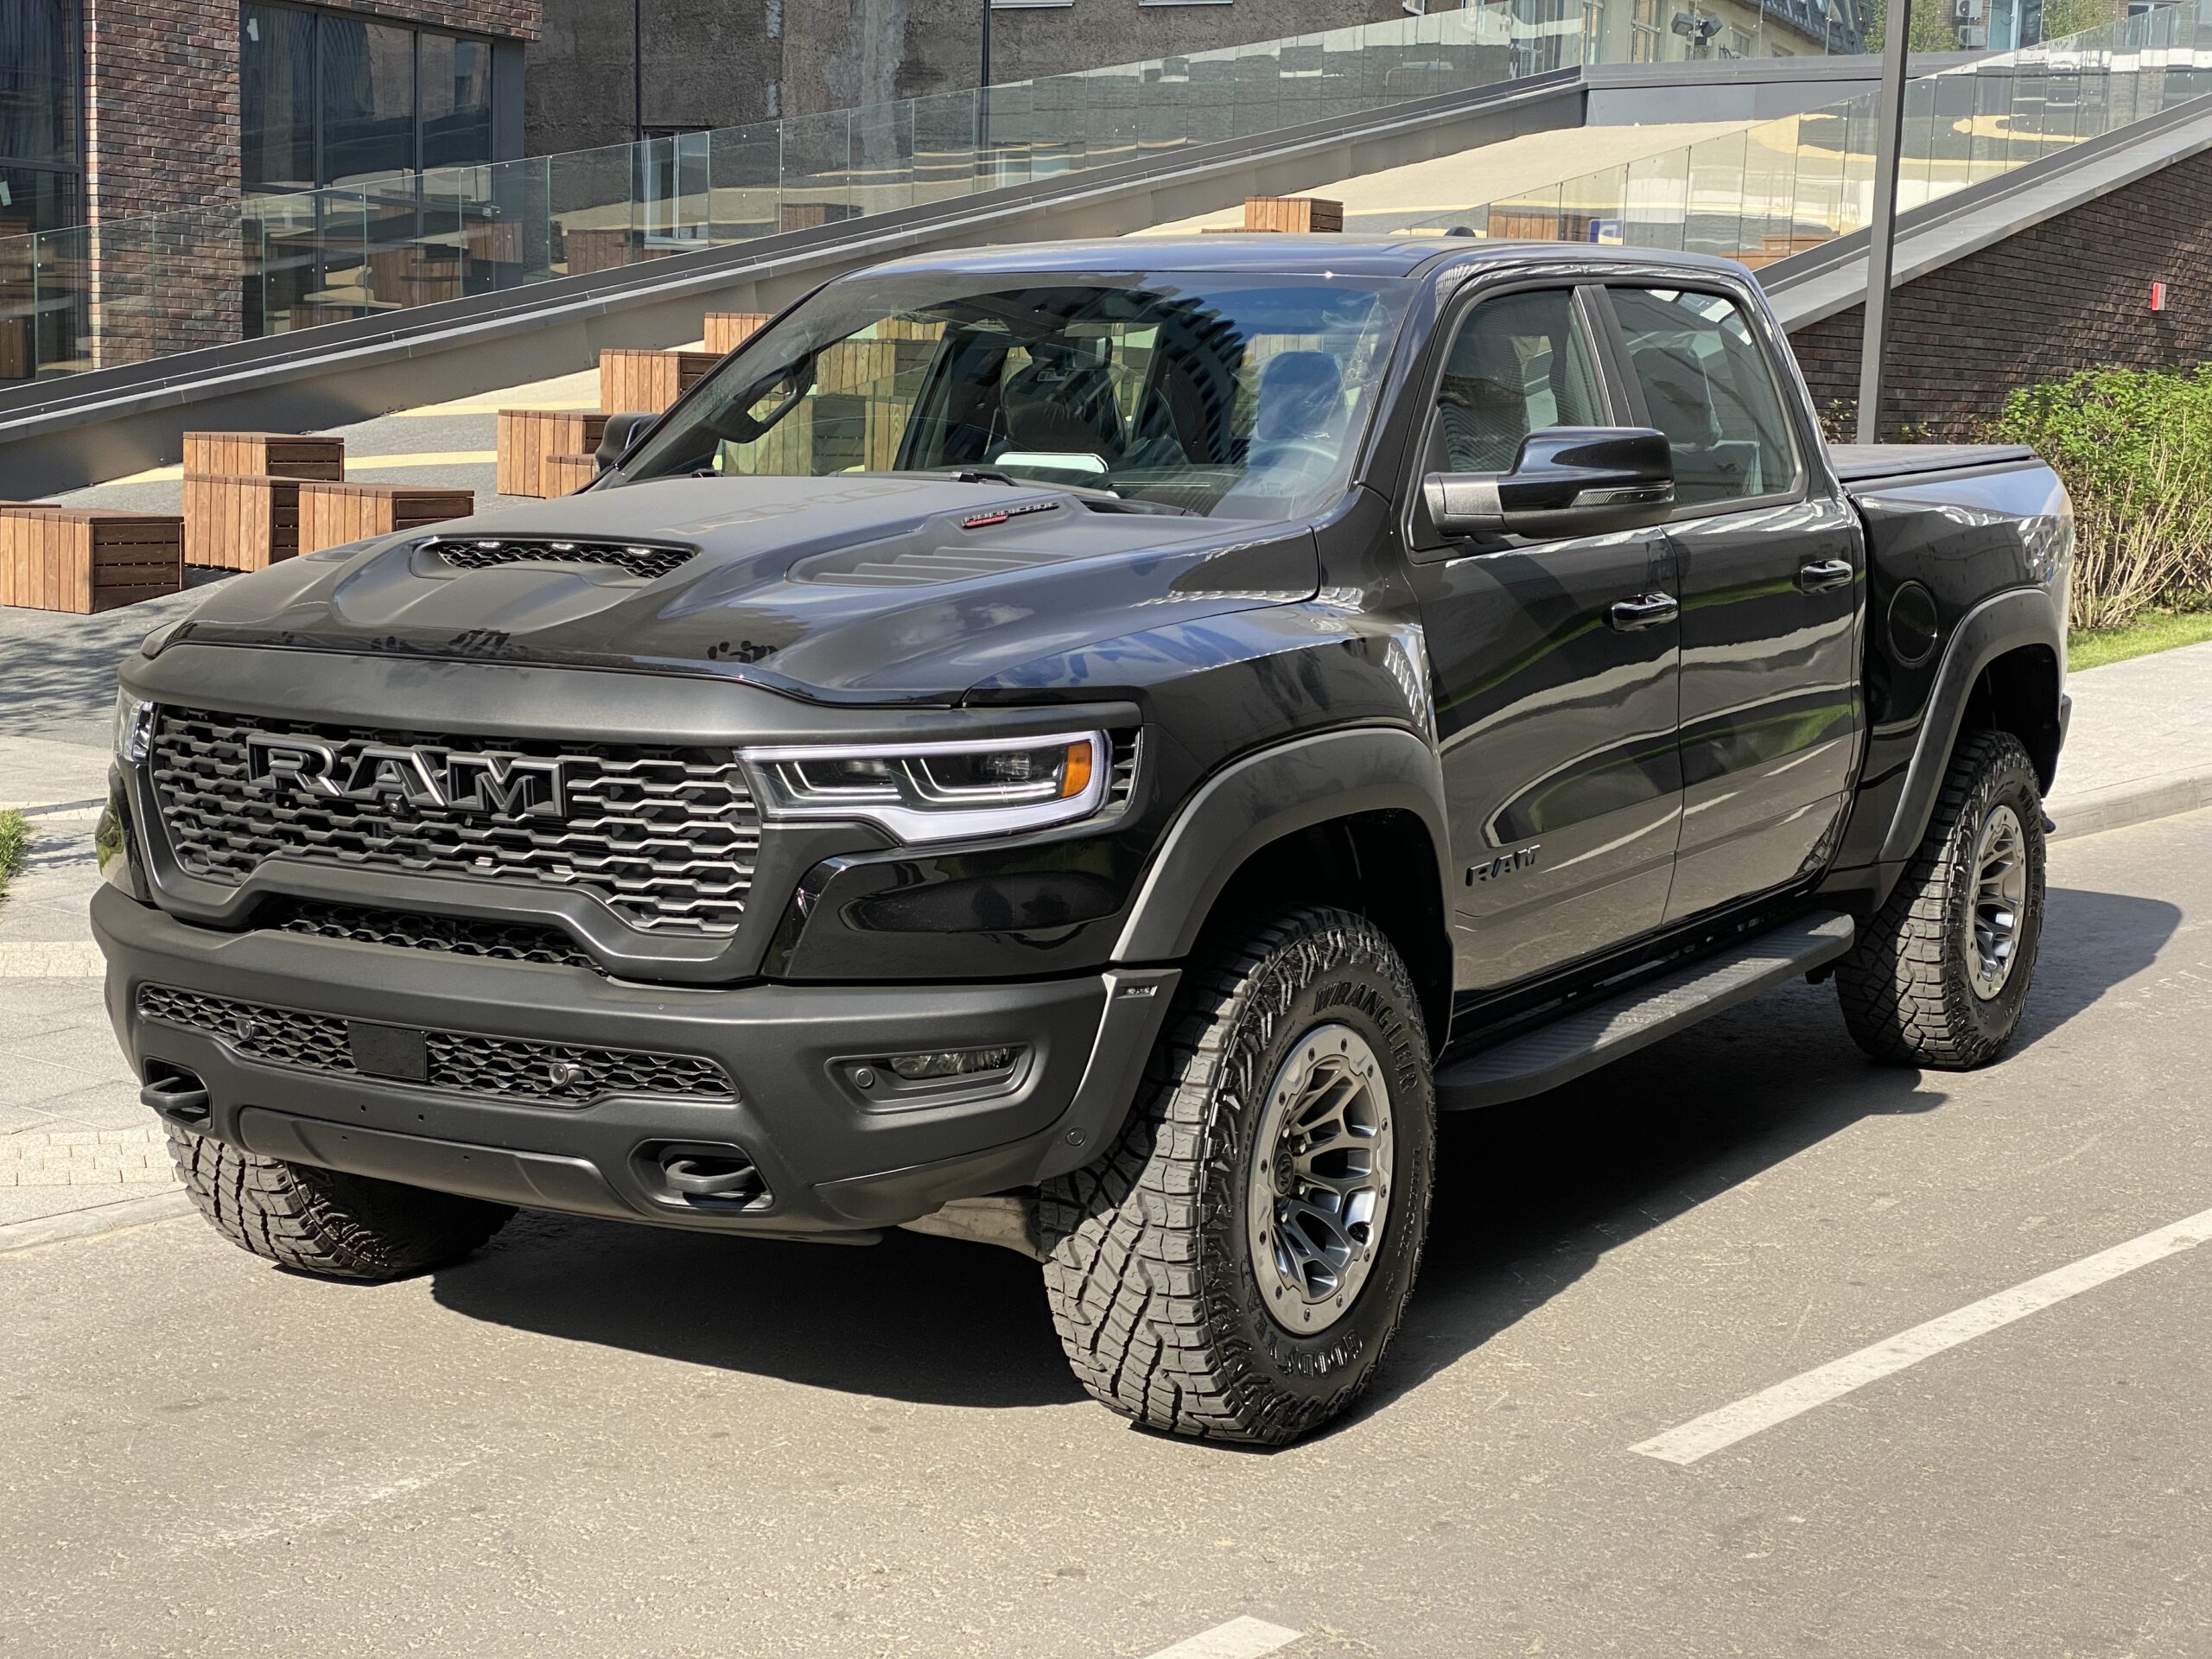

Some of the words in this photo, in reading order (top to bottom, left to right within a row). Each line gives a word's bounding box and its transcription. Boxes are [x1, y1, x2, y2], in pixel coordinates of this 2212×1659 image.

[245, 733, 564, 817] RAM
[1465, 844, 1541, 887] RAM
[2018, 784, 2043, 918] WRANGLER
[1313, 982, 1417, 1094] WRANGLER
